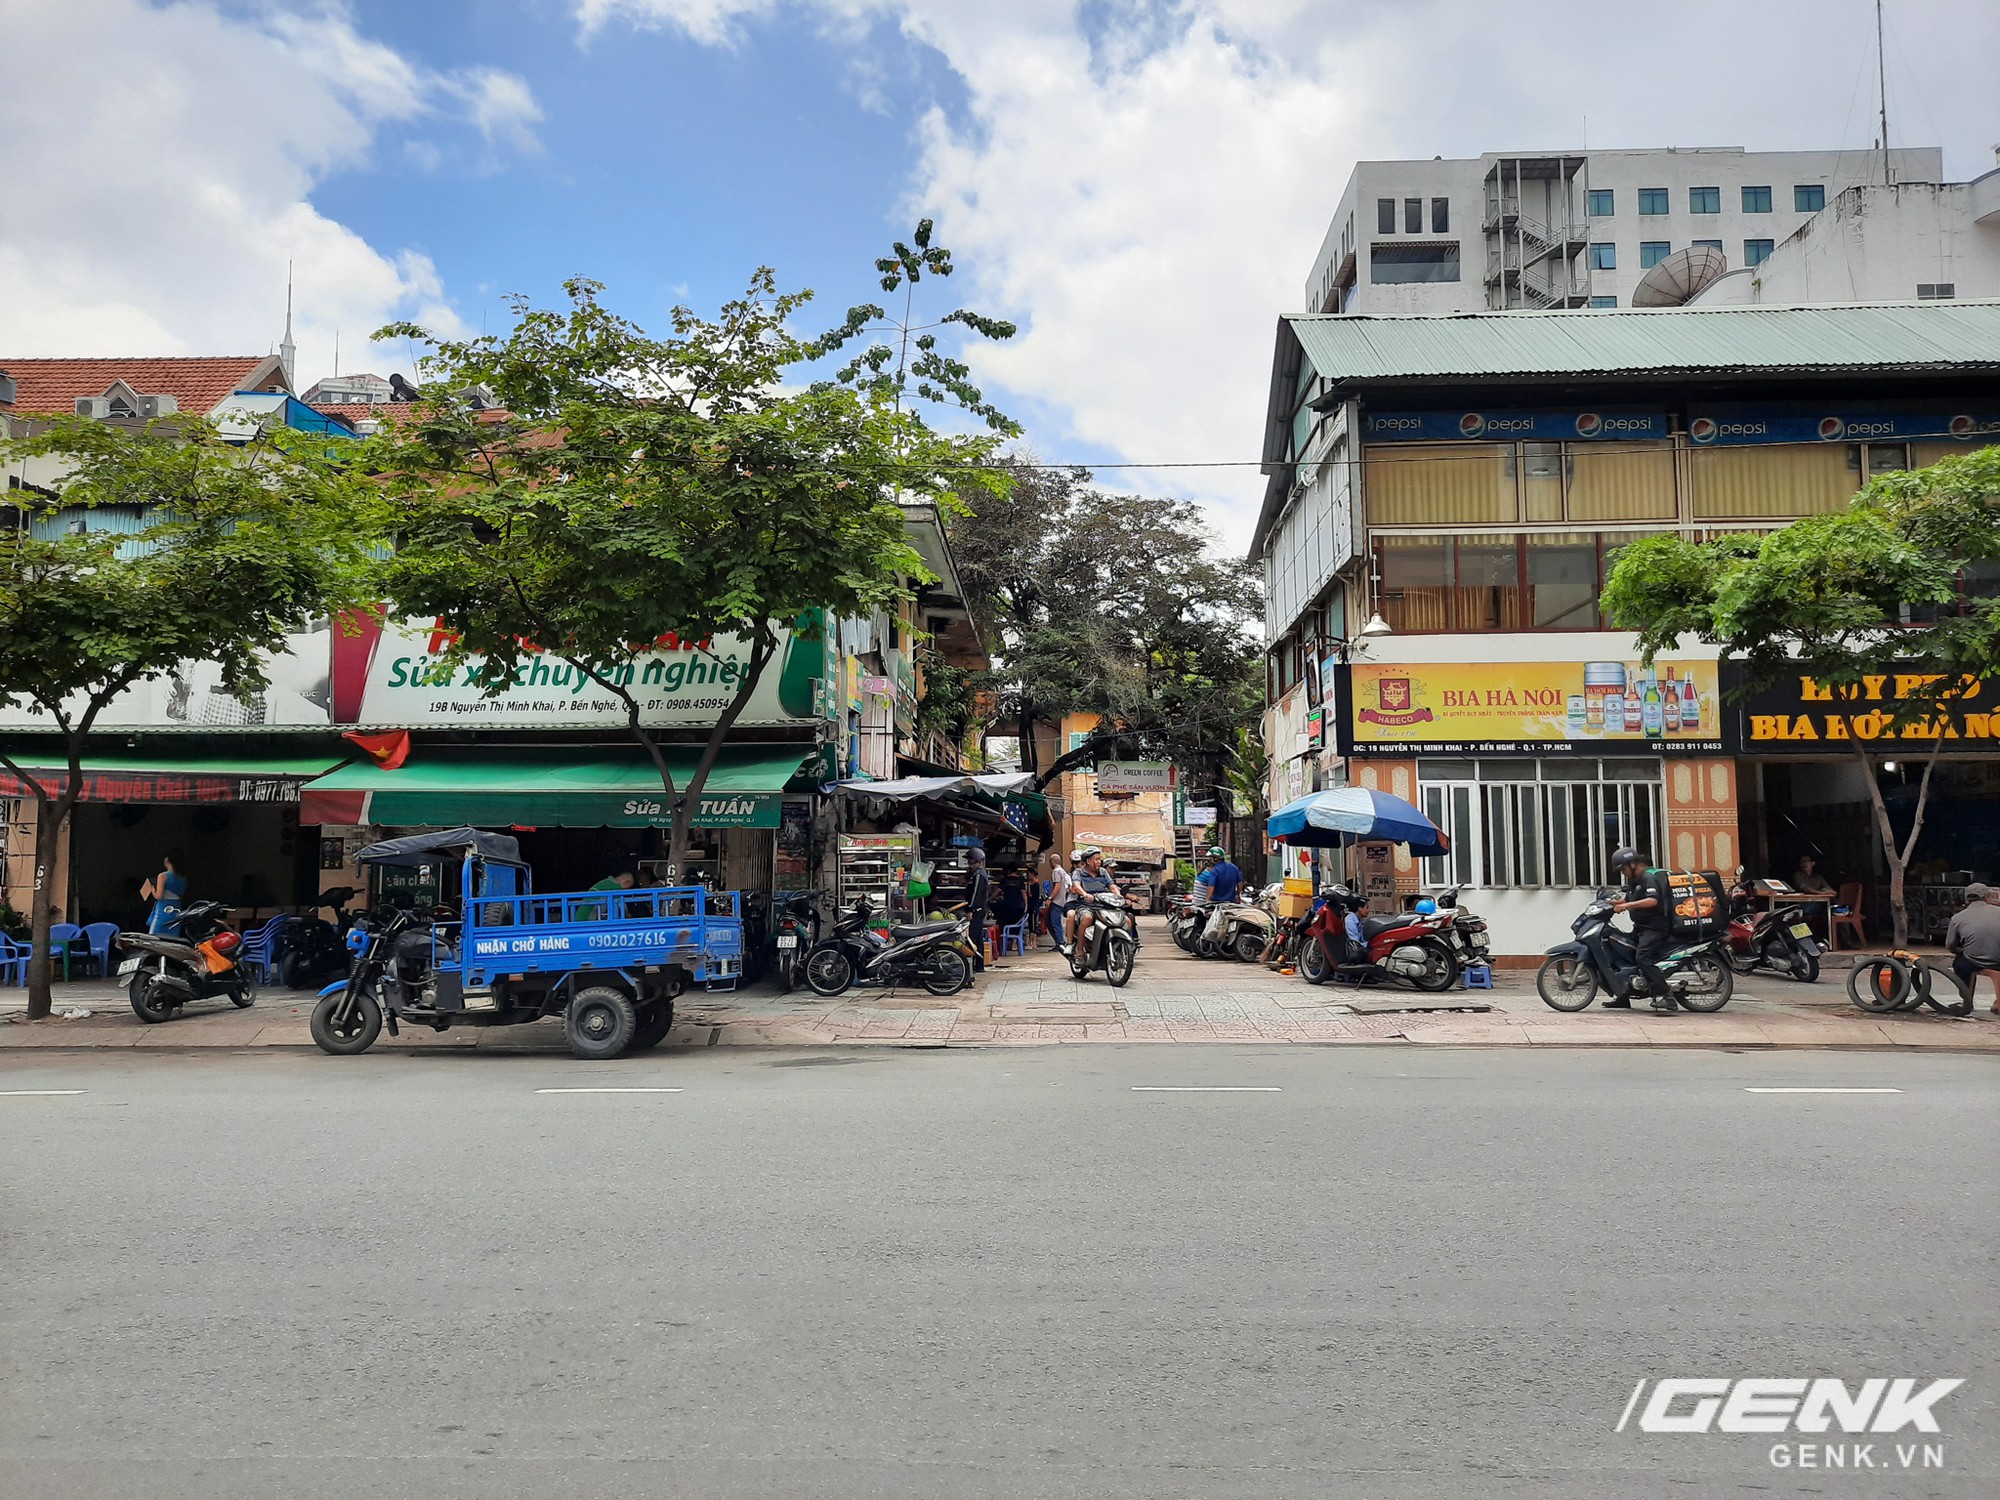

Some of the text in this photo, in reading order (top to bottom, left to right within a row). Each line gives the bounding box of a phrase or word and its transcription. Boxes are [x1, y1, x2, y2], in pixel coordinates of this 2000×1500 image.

[1375, 416, 1421, 431] pepsi
[1487, 417, 1534, 432] pepsi
[1604, 416, 1652, 432] pepsi
[1719, 421, 1767, 437] pepsi
[1847, 420, 1895, 437] pepsi
[1442, 687, 1563, 708] BIA HÀ NỘI
[429, 701, 448, 713] 19B
[489, 701, 504, 714] Thị
[506, 700, 530, 712] Minh
[531, 700, 556, 713] Khai,
[558, 701, 567, 711] P.
[570, 698, 588, 711] Bến
[591, 698, 618, 714] Nghé,
[647, 700, 664, 711] ĐT:
[666, 698, 730, 710] 0908.450954
[1377, 715, 1414, 725] HABECO
[1749, 714, 1819, 740] BIA
[1368, 744, 1378, 752] 19
[1409, 744, 1422, 753] THỊ
[1423, 744, 1443, 752] MINH
[1445, 744, 1463, 752] KHAI
[1479, 741, 1494, 751] BẾN
[1496, 742, 1516, 751] NGHÉ
[1523, 743, 1535, 752] Q.1
[1543, 743, 1572, 751] TP.HCM
[1703, 742, 1722, 750] 0453
[1124, 769, 1163, 777] GREEN COFFEE
[623, 794, 756, 815] Sửa TUẤN
[1075, 830, 1157, 845] Coca-Cola
[477, 931, 667, 956] NHẬN CHỞ HÀNG 0902027616
